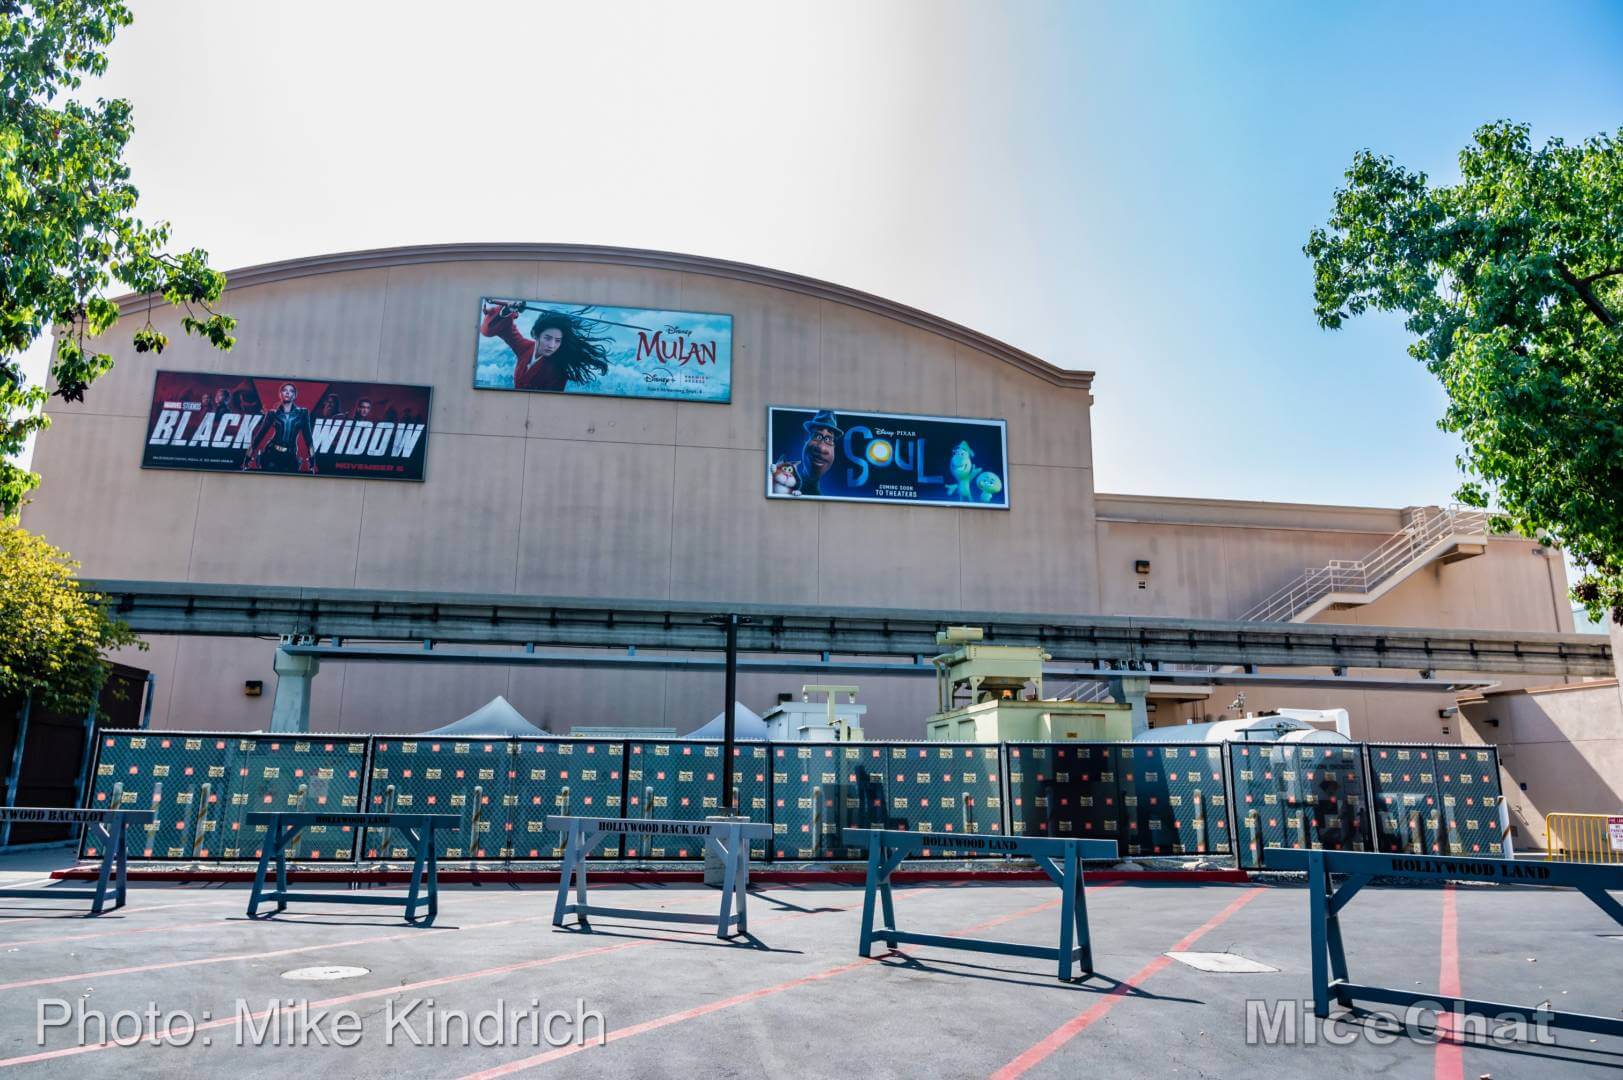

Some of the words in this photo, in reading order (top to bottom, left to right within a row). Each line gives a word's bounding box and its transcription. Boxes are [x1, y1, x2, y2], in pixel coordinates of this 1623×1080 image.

[636, 331, 716, 366] MULAN
[150, 409, 263, 450] BLACK
[311, 418, 425, 458] WIDOW
[843, 425, 944, 487] SOUL
[885, 490, 917, 498] THEATERS
[0, 809, 45, 821] YWOOD
[598, 821, 659, 833] HOLLYWOOD
[661, 824, 689, 834] BACK
[692, 825, 712, 835] LOT
[922, 836, 985, 849] HOLLYWOOD
[989, 839, 1018, 850] LAND
[1392, 858, 1495, 876] HOLLYWOOD
[1501, 864, 1550, 880] LAND
